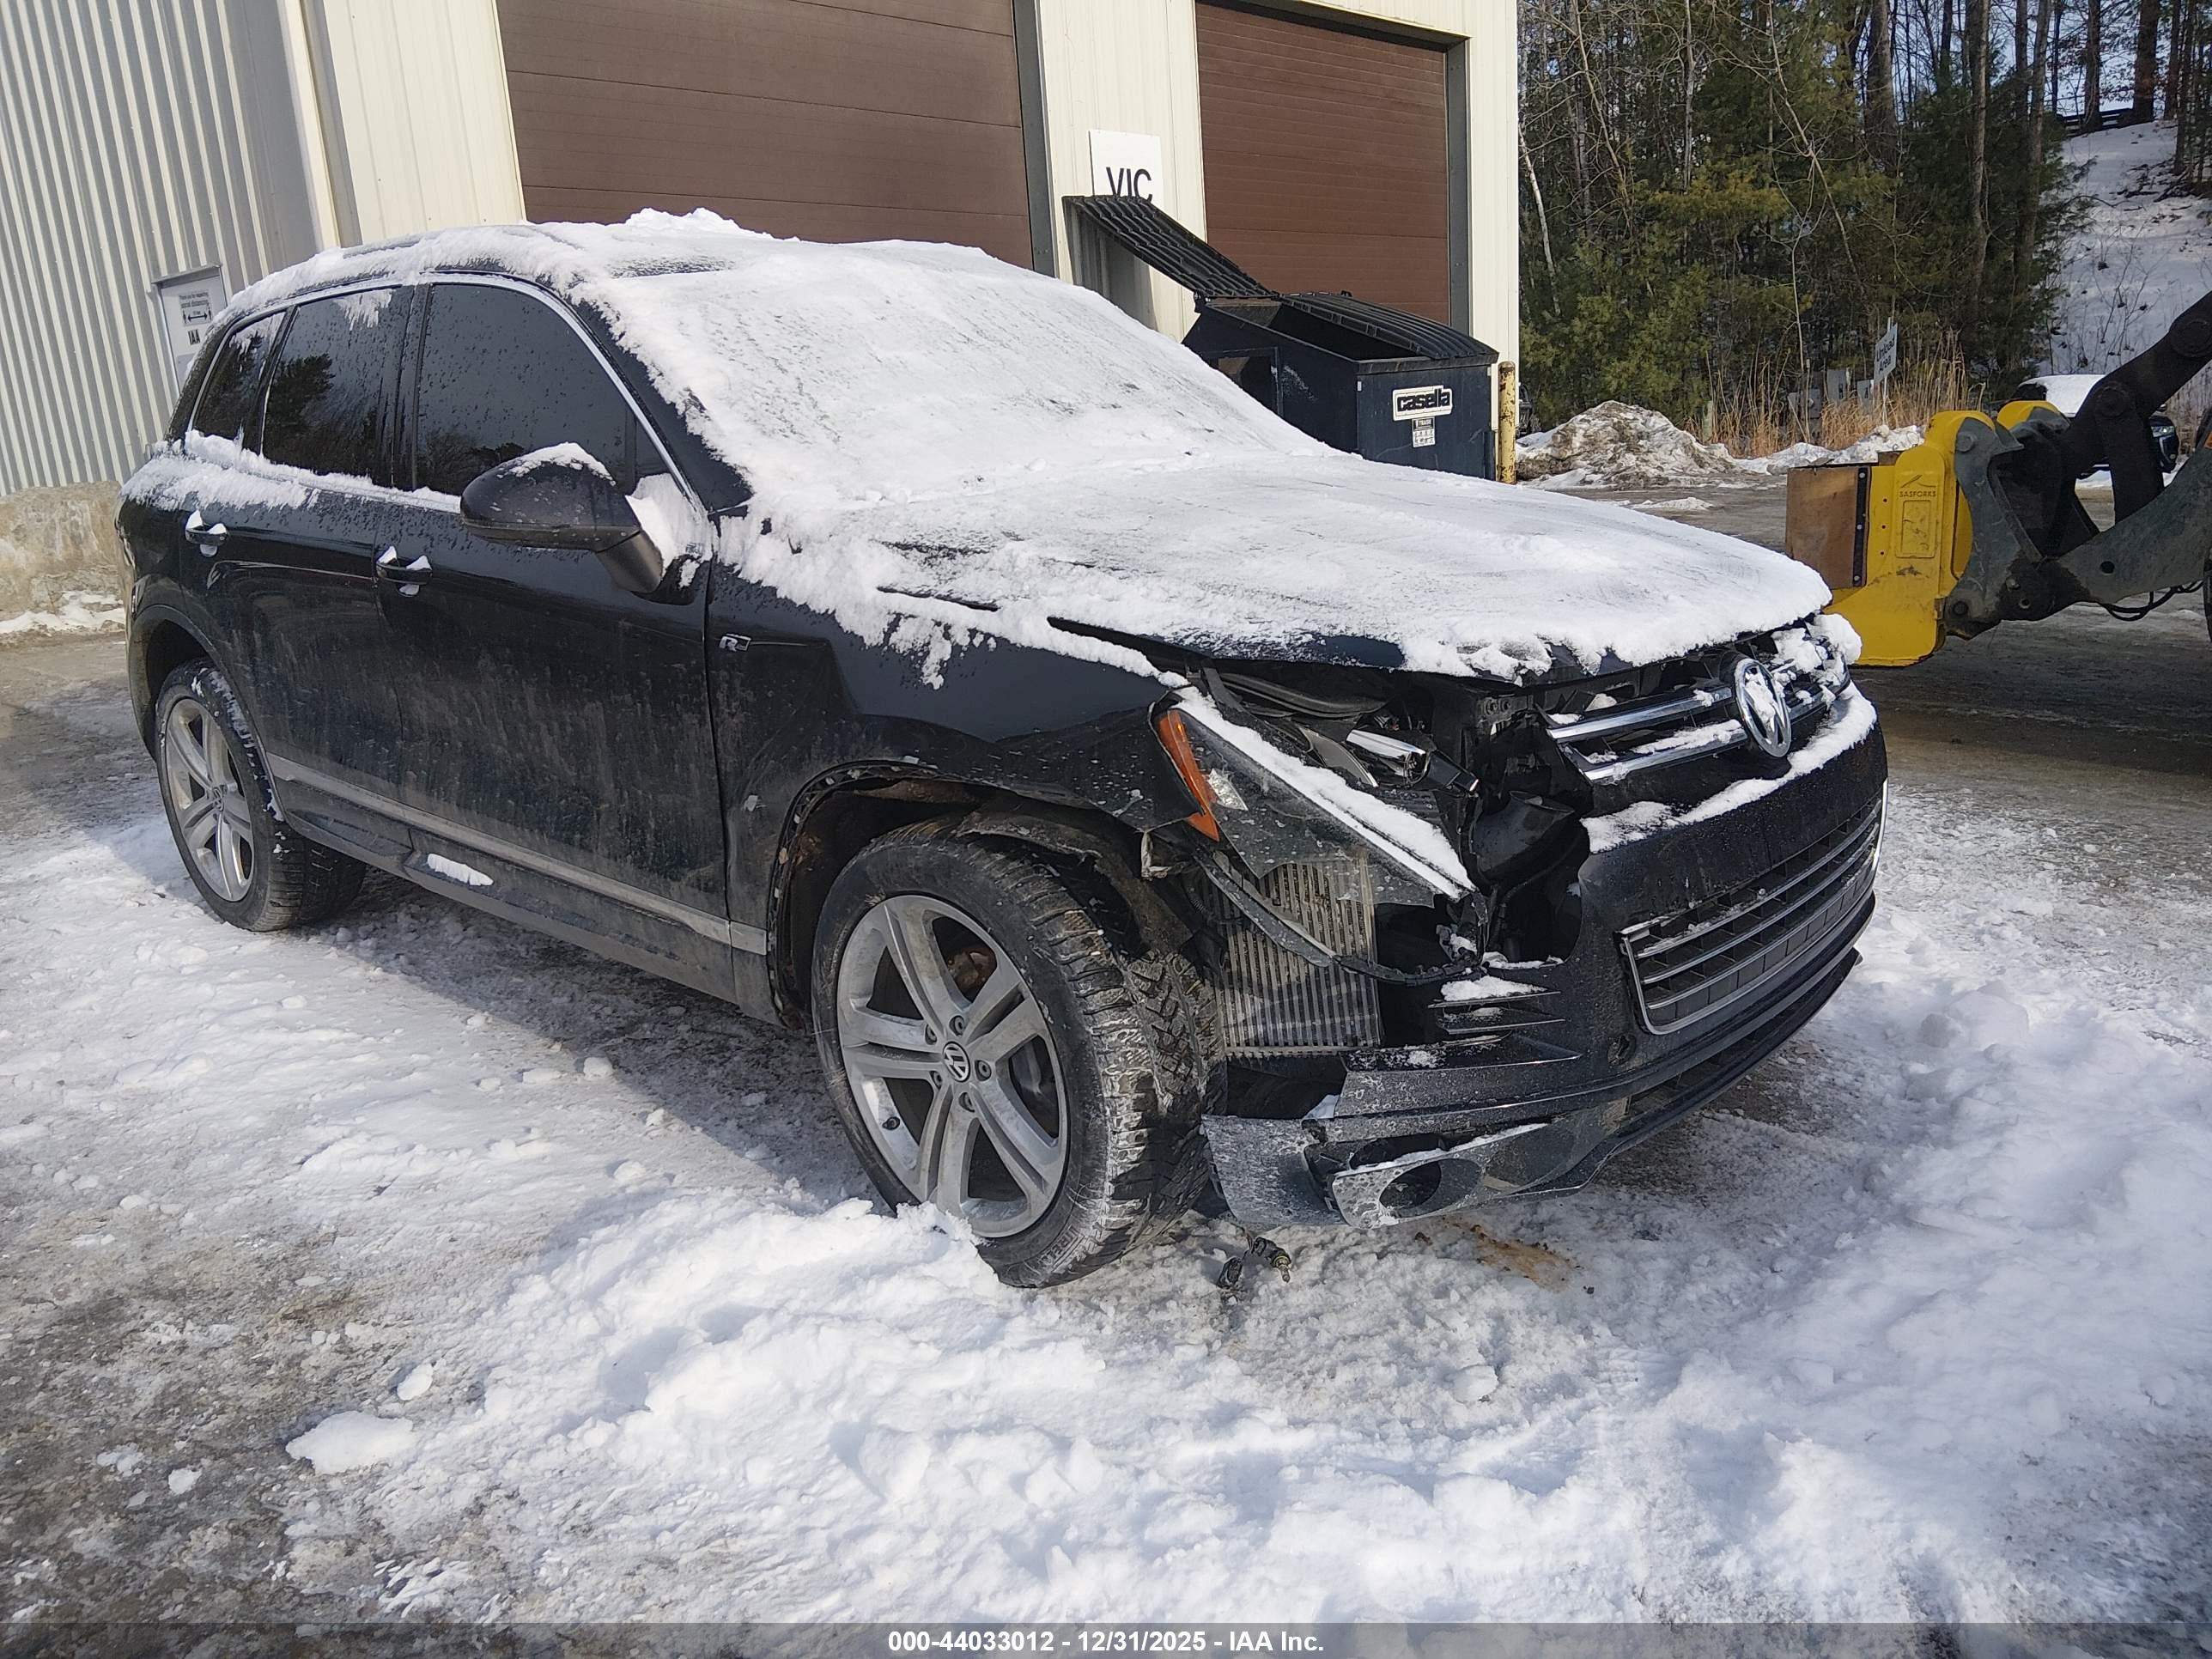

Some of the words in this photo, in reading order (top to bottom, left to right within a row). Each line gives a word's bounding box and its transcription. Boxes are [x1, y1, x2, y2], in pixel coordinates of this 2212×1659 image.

[1105, 167, 1152, 203] VIC
[188, 329, 201, 345] IAA
[1396, 388, 1450, 412] casella
